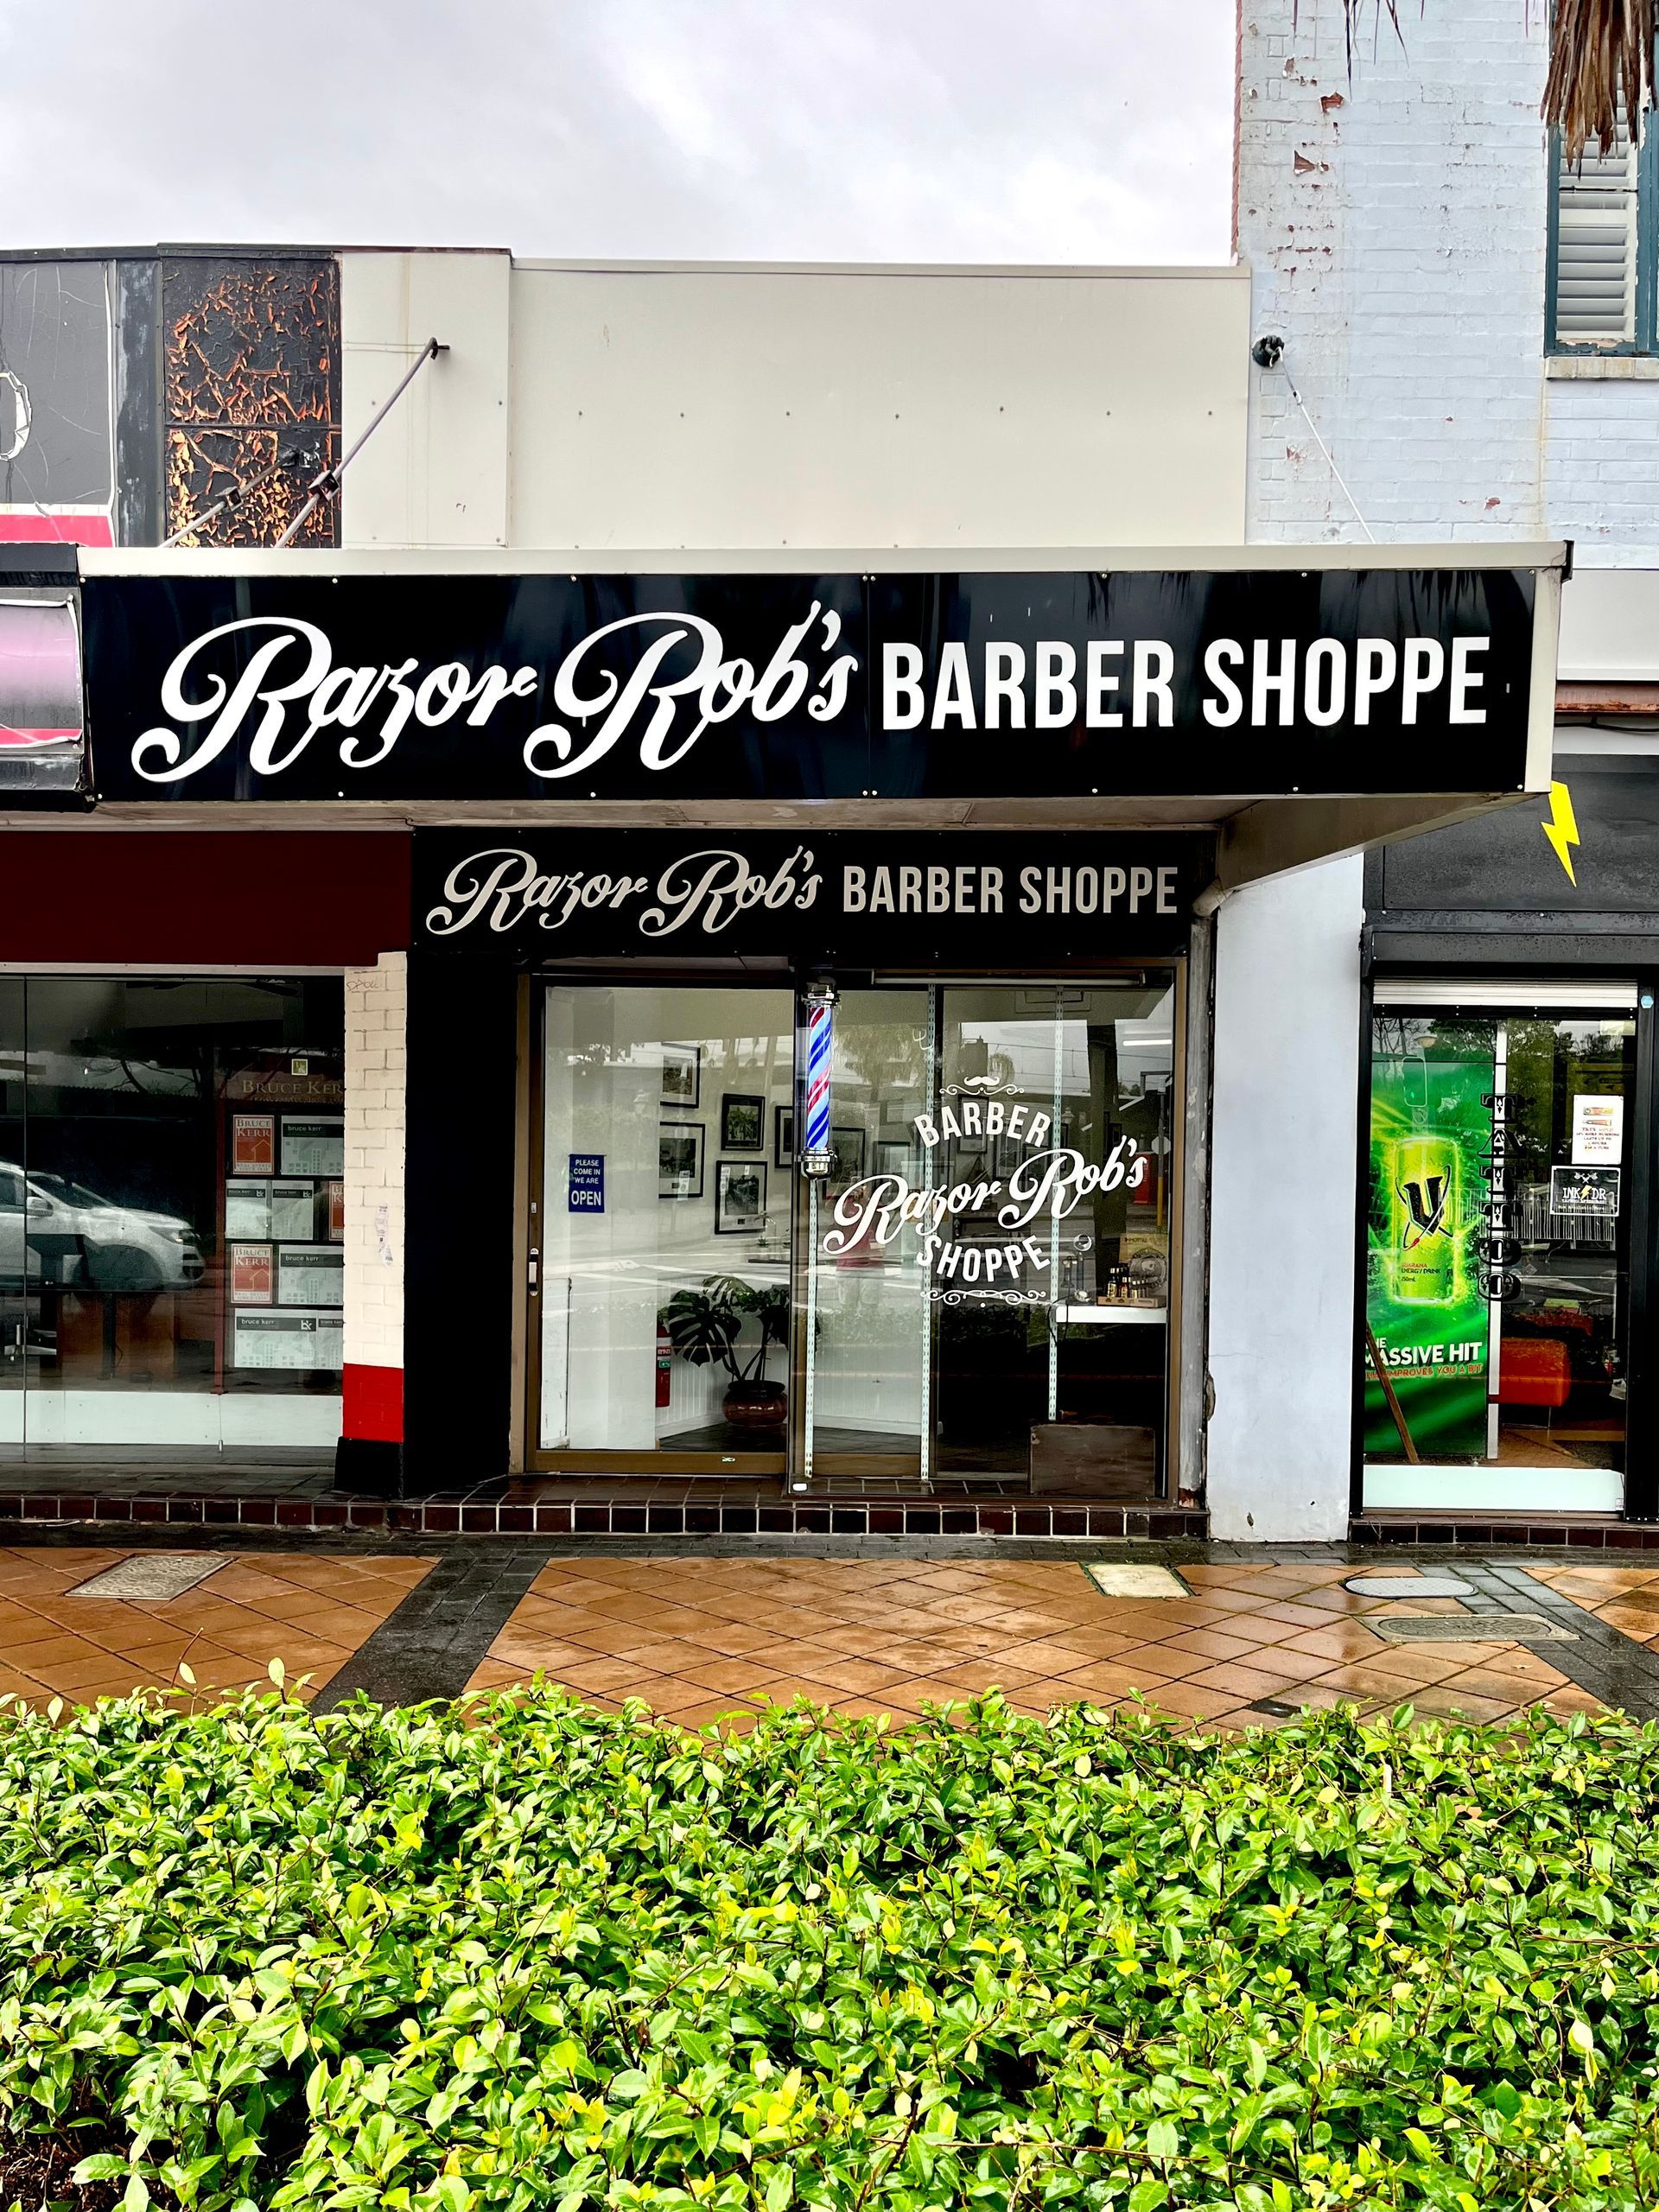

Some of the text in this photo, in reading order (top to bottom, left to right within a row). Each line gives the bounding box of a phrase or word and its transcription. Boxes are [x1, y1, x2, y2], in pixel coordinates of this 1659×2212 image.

[131, 601, 1489, 782] Razor Rob's BARBER SHOPPE
[426, 846, 1177, 936] Razor Rob's BARBER SHOPPE
[243, 1080, 302, 1094] BRUCE
[237, 1128, 270, 1137] KERR
[913, 1102, 1051, 1148] BARBER
[571, 1190, 601, 1205] OPEN
[823, 1135, 1147, 1255] Razor Rob's
[1478, 1093, 1527, 1302] TATTOO
[1562, 1187, 1606, 1200] INK DR
[235, 1248, 268, 1256] BRUCE
[916, 1235, 1051, 1282] SHOPPE
[235, 1257, 268, 1266] KERR
[1365, 1338, 1386, 1349] HE
[1449, 1342, 1482, 1362] HIT
[1437, 1365, 1456, 1374] YOU
[1468, 1363, 1483, 1373] BIT
